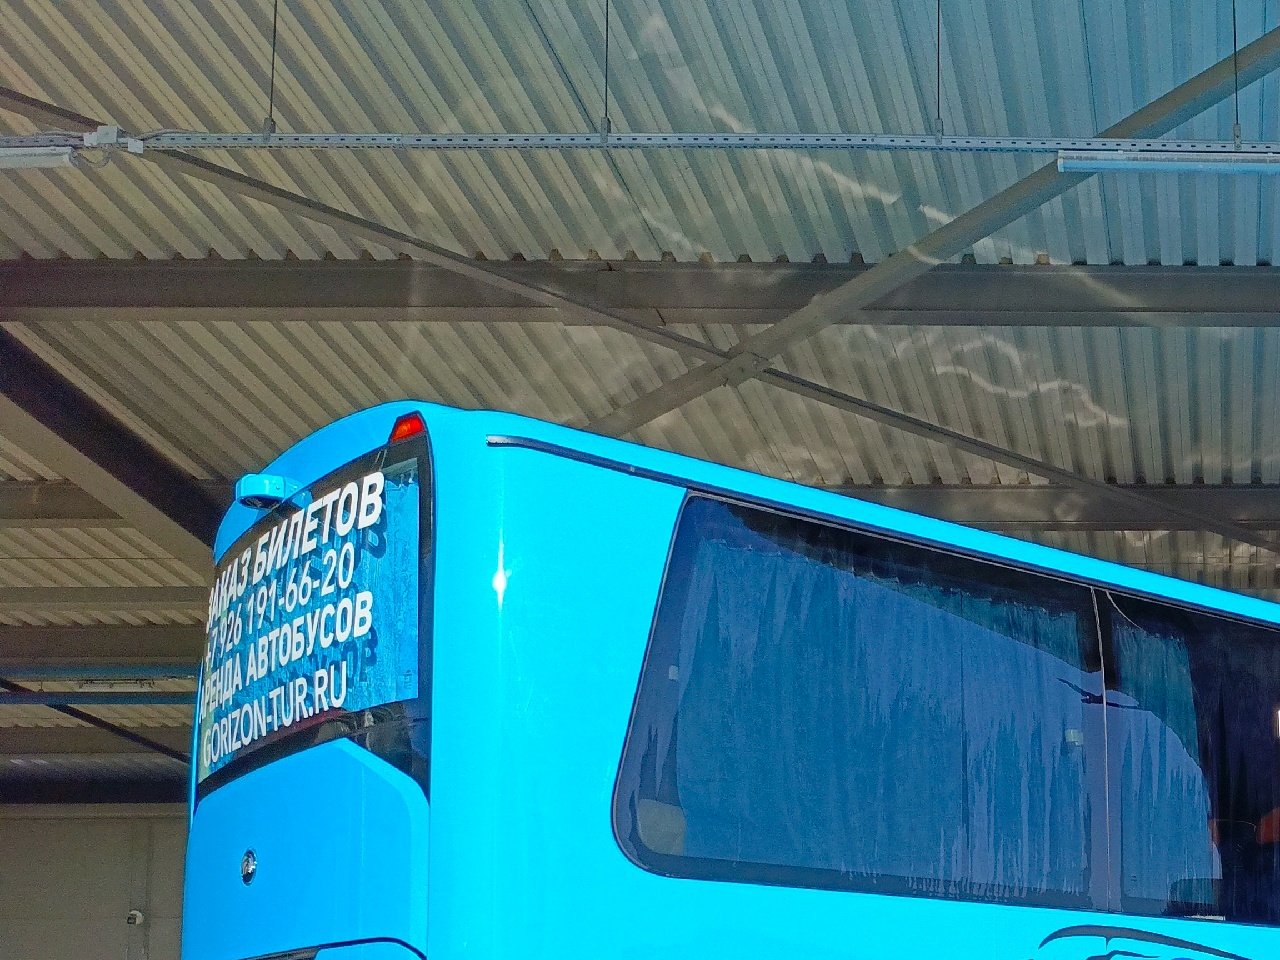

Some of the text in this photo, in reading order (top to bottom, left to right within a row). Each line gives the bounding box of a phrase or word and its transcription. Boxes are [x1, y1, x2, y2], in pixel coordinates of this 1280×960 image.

[205, 471, 385, 634] ЗАКАЗ БИЛЕТОВ
[205, 542, 355, 672] +7 926 191-66-20
[199, 590, 373, 724] АРЕНДА АВТОБУСОВ
[203, 661, 347, 768] GORIZON-TUR.RU
